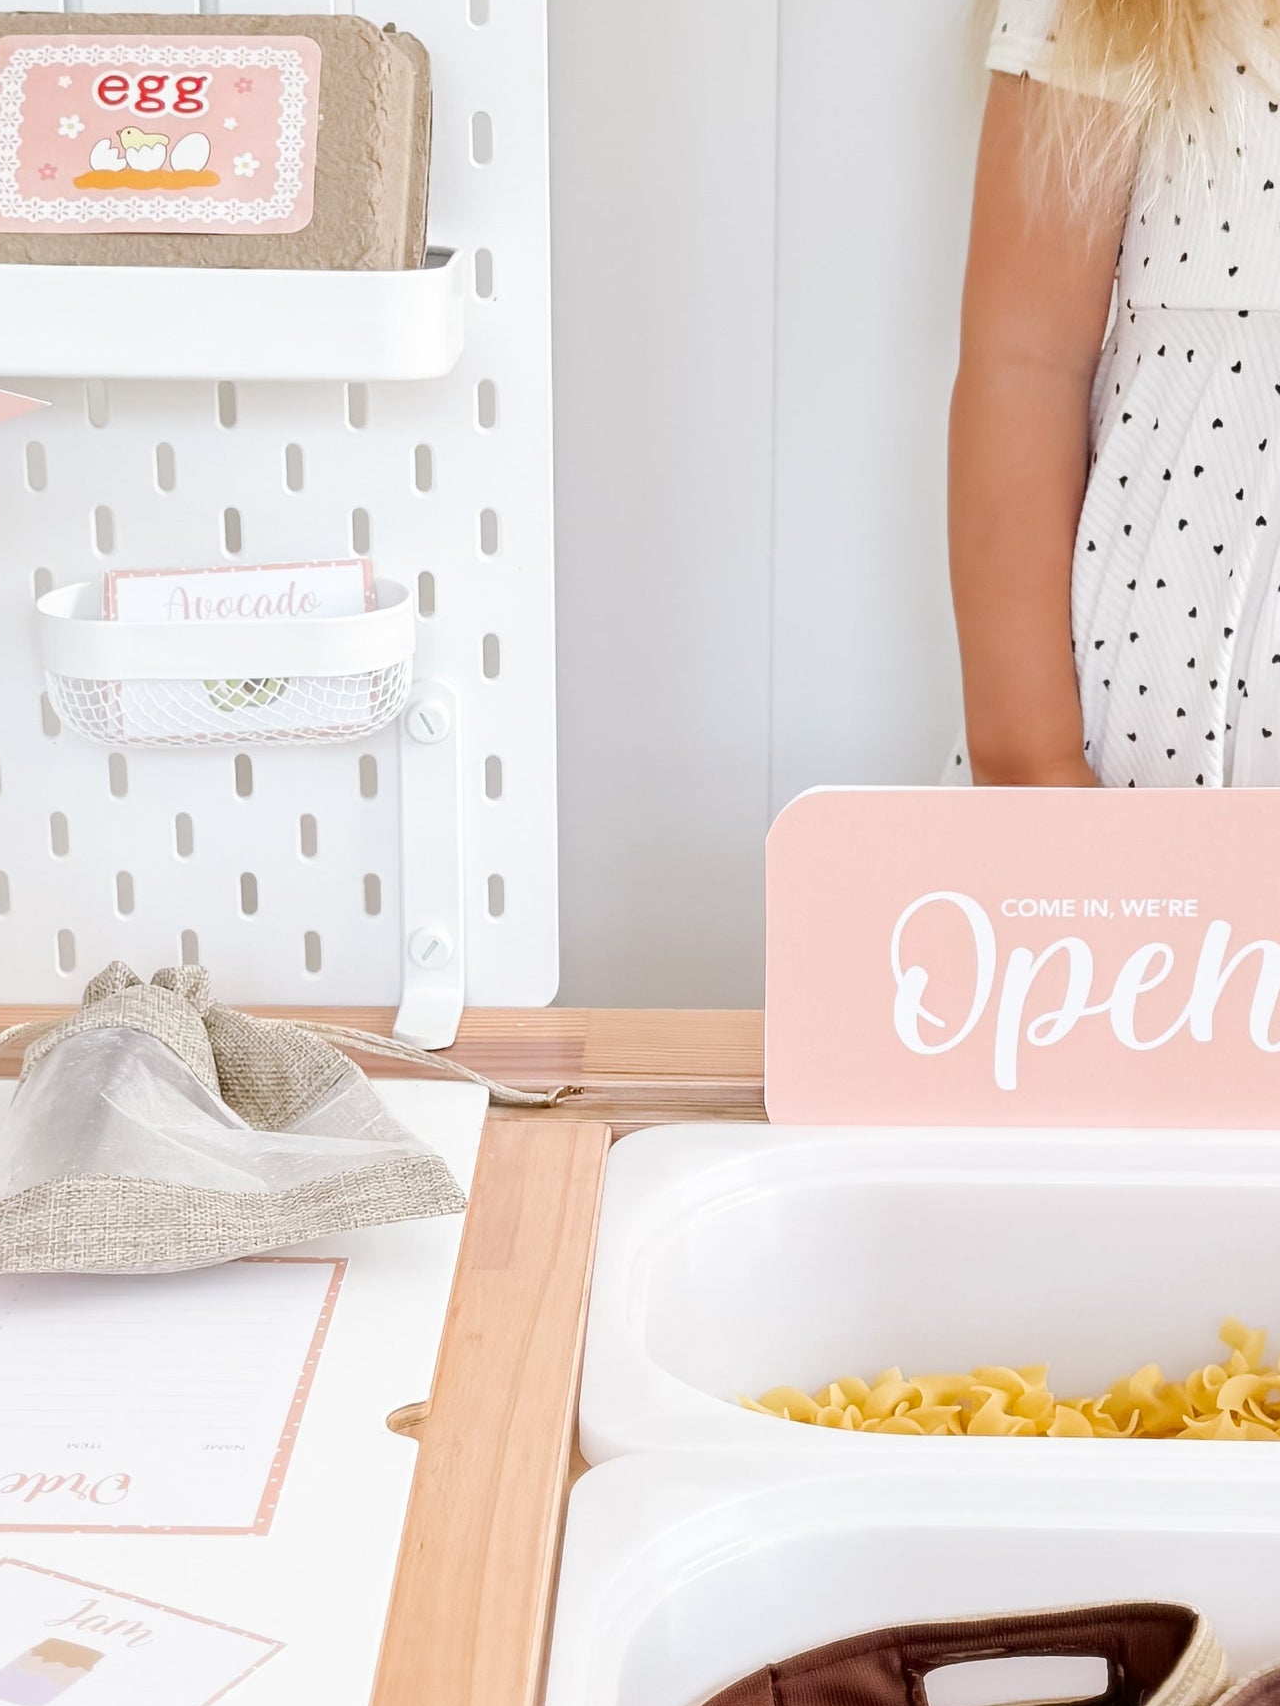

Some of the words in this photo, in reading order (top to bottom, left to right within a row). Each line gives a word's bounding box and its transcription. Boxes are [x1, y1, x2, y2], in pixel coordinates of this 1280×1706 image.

[98, 74, 207, 113] egg
[162, 581, 322, 621] Avocado
[1001, 899, 1076, 918] COME
[1083, 899, 1115, 920] IN,
[1121, 899, 1199, 918] WE'RE
[66, 1441, 102, 1449] ITEM
[44, 1598, 154, 1647] Jam
